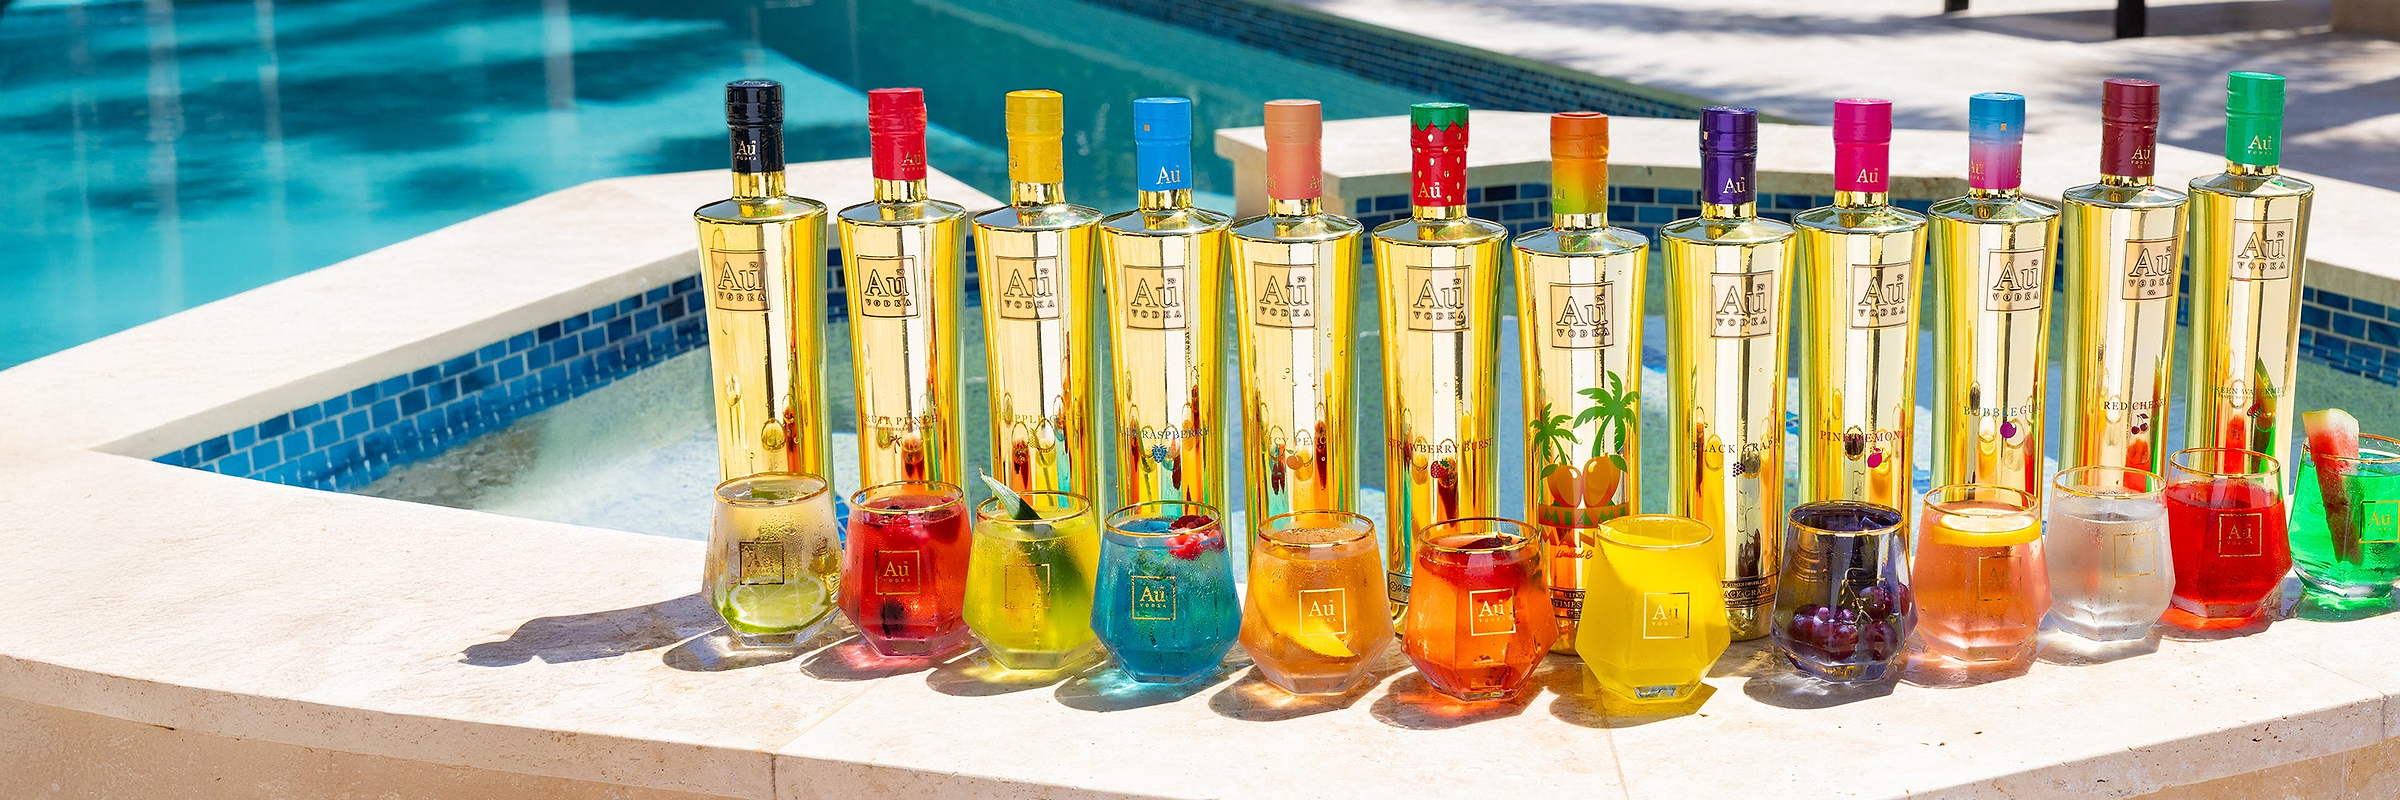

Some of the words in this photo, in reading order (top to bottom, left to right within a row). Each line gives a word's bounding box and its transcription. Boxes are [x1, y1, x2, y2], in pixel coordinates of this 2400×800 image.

[2237, 261, 2286, 270] VODKA
[718, 291, 768, 301] VODKA
[1993, 291, 2040, 301] VODKA
[865, 298, 912, 308] VODKA
[1004, 299, 1055, 309] VODKA
[1131, 308, 1182, 319] VODKA
[1260, 306, 1311, 317] VODKA
[1858, 306, 1906, 317] VODKA
[1716, 316, 1768, 326] VODKA
[1557, 328, 1610, 338] VODKA
[2103, 401, 2128, 411] RED
[896, 414, 938, 425] PUNCH
[1142, 426, 1209, 439] RASPBERRY
[1820, 430, 1851, 443] PINK
[1387, 438, 1459, 453] STRAWBERRY
[1463, 437, 1493, 452] BURST
[1692, 442, 1736, 454] BLACK
[1543, 507, 1625, 525] MIAMI
[1744, 585, 1771, 597] GRAPE
